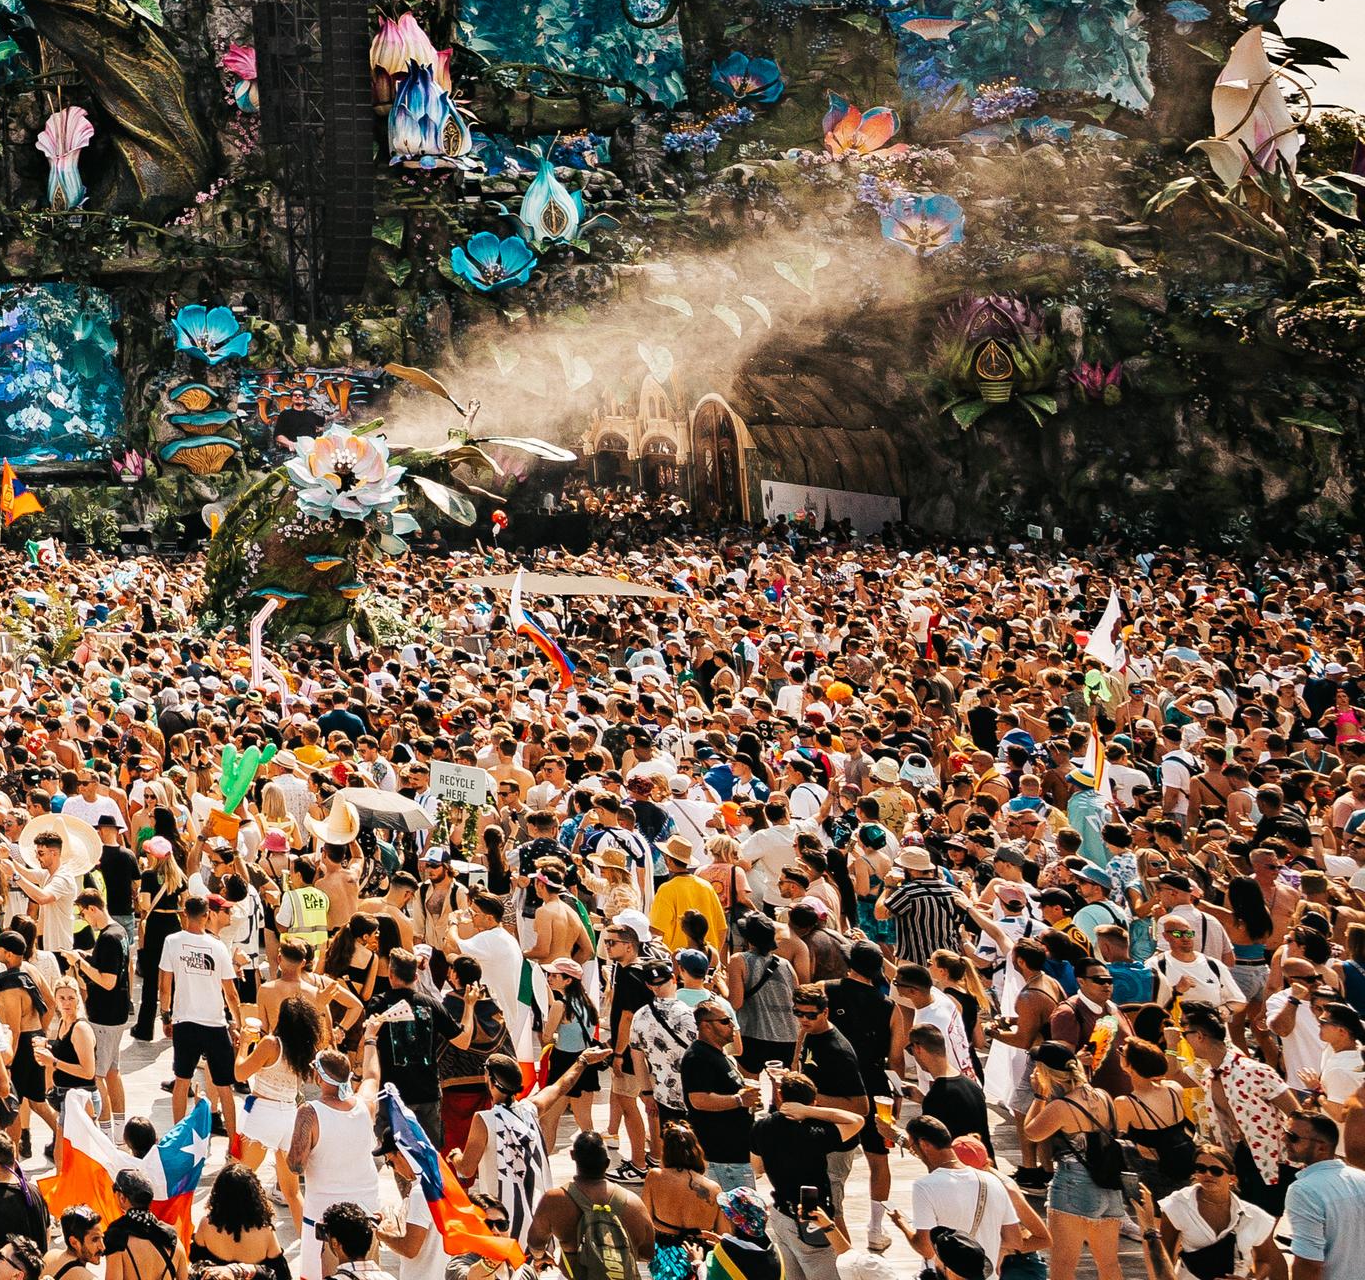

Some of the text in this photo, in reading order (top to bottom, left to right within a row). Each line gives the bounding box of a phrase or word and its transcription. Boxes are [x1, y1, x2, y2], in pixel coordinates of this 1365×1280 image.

[439, 774, 476, 790] RECYCLE
[446, 788, 468, 801] HERE
[189, 950, 203, 959] THE
[179, 955, 204, 964] NORTH
[186, 961, 204, 970] FACE
